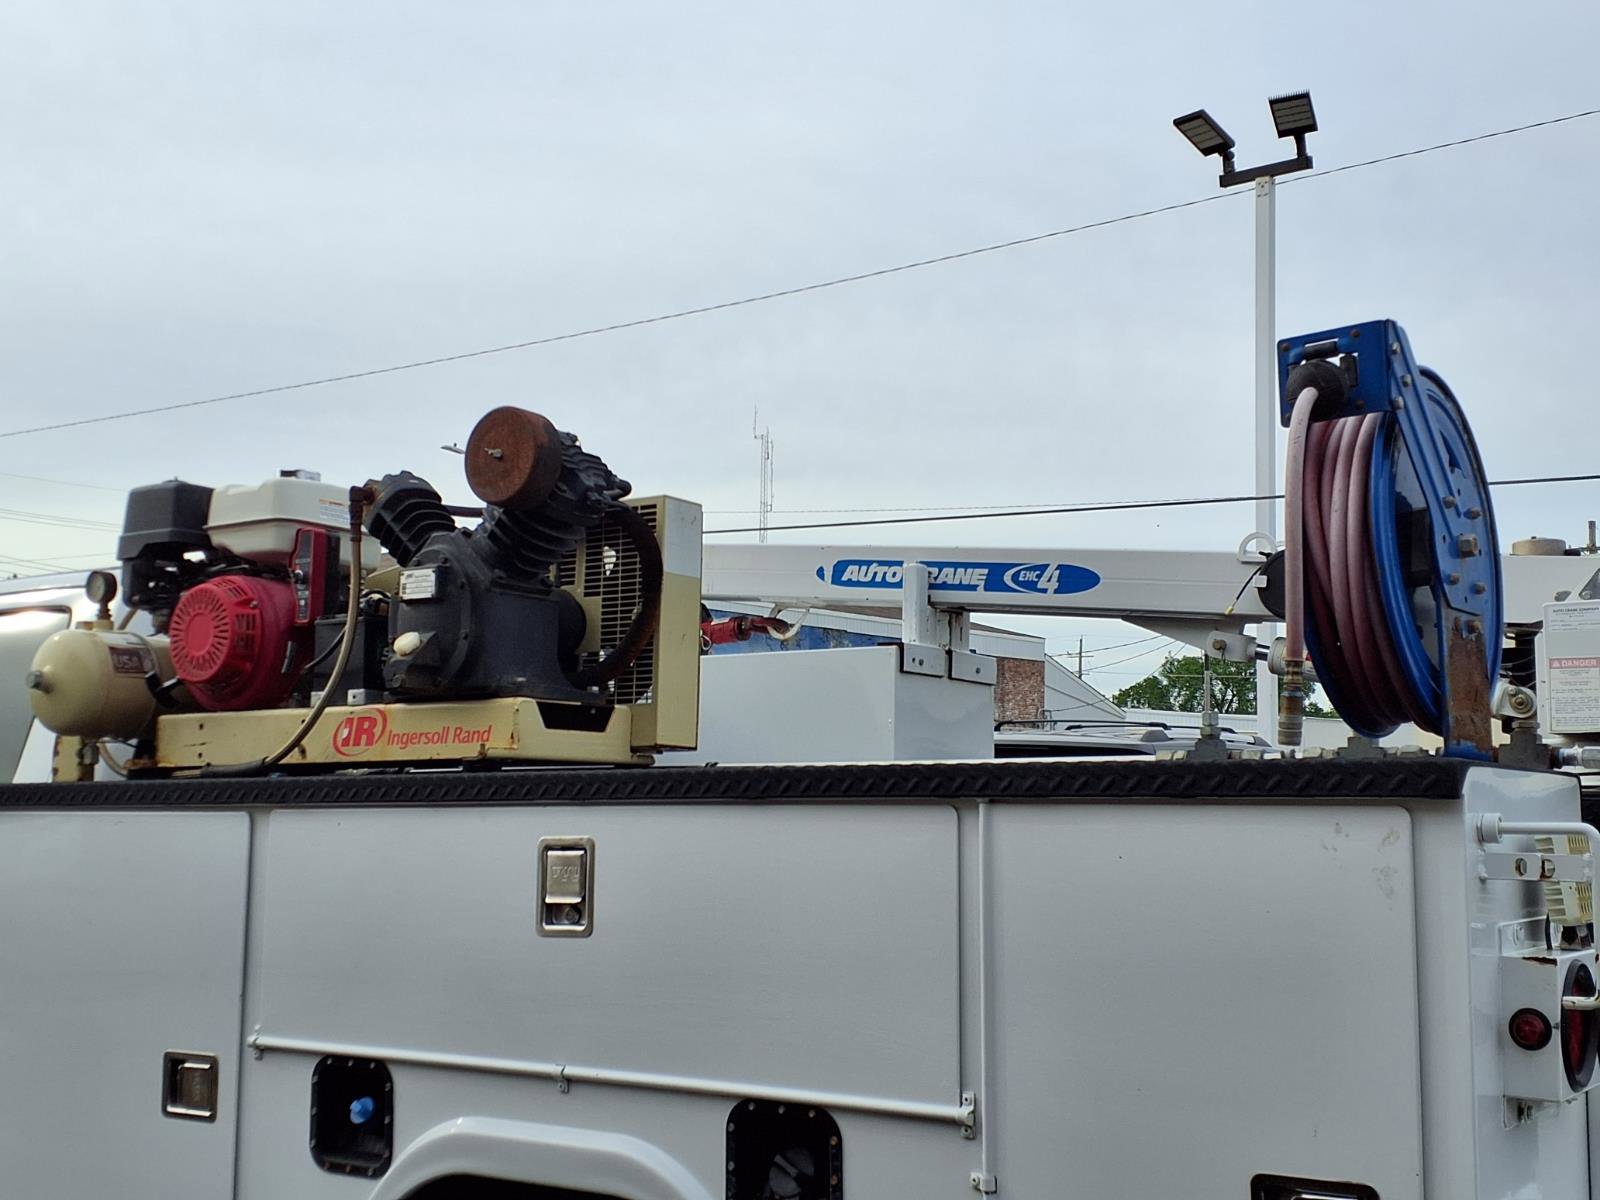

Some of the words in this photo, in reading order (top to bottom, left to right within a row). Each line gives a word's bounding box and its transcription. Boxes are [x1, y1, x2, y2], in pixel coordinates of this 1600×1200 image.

[841, 563, 903, 583] AUTO
[928, 567, 989, 592] RANE
[1019, 571, 1041, 581] EHC
[1037, 560, 1060, 594] 4
[1561, 659, 1597, 667] DANGER
[387, 726, 450, 750] Ingersoll
[452, 724, 493, 743] Rand
